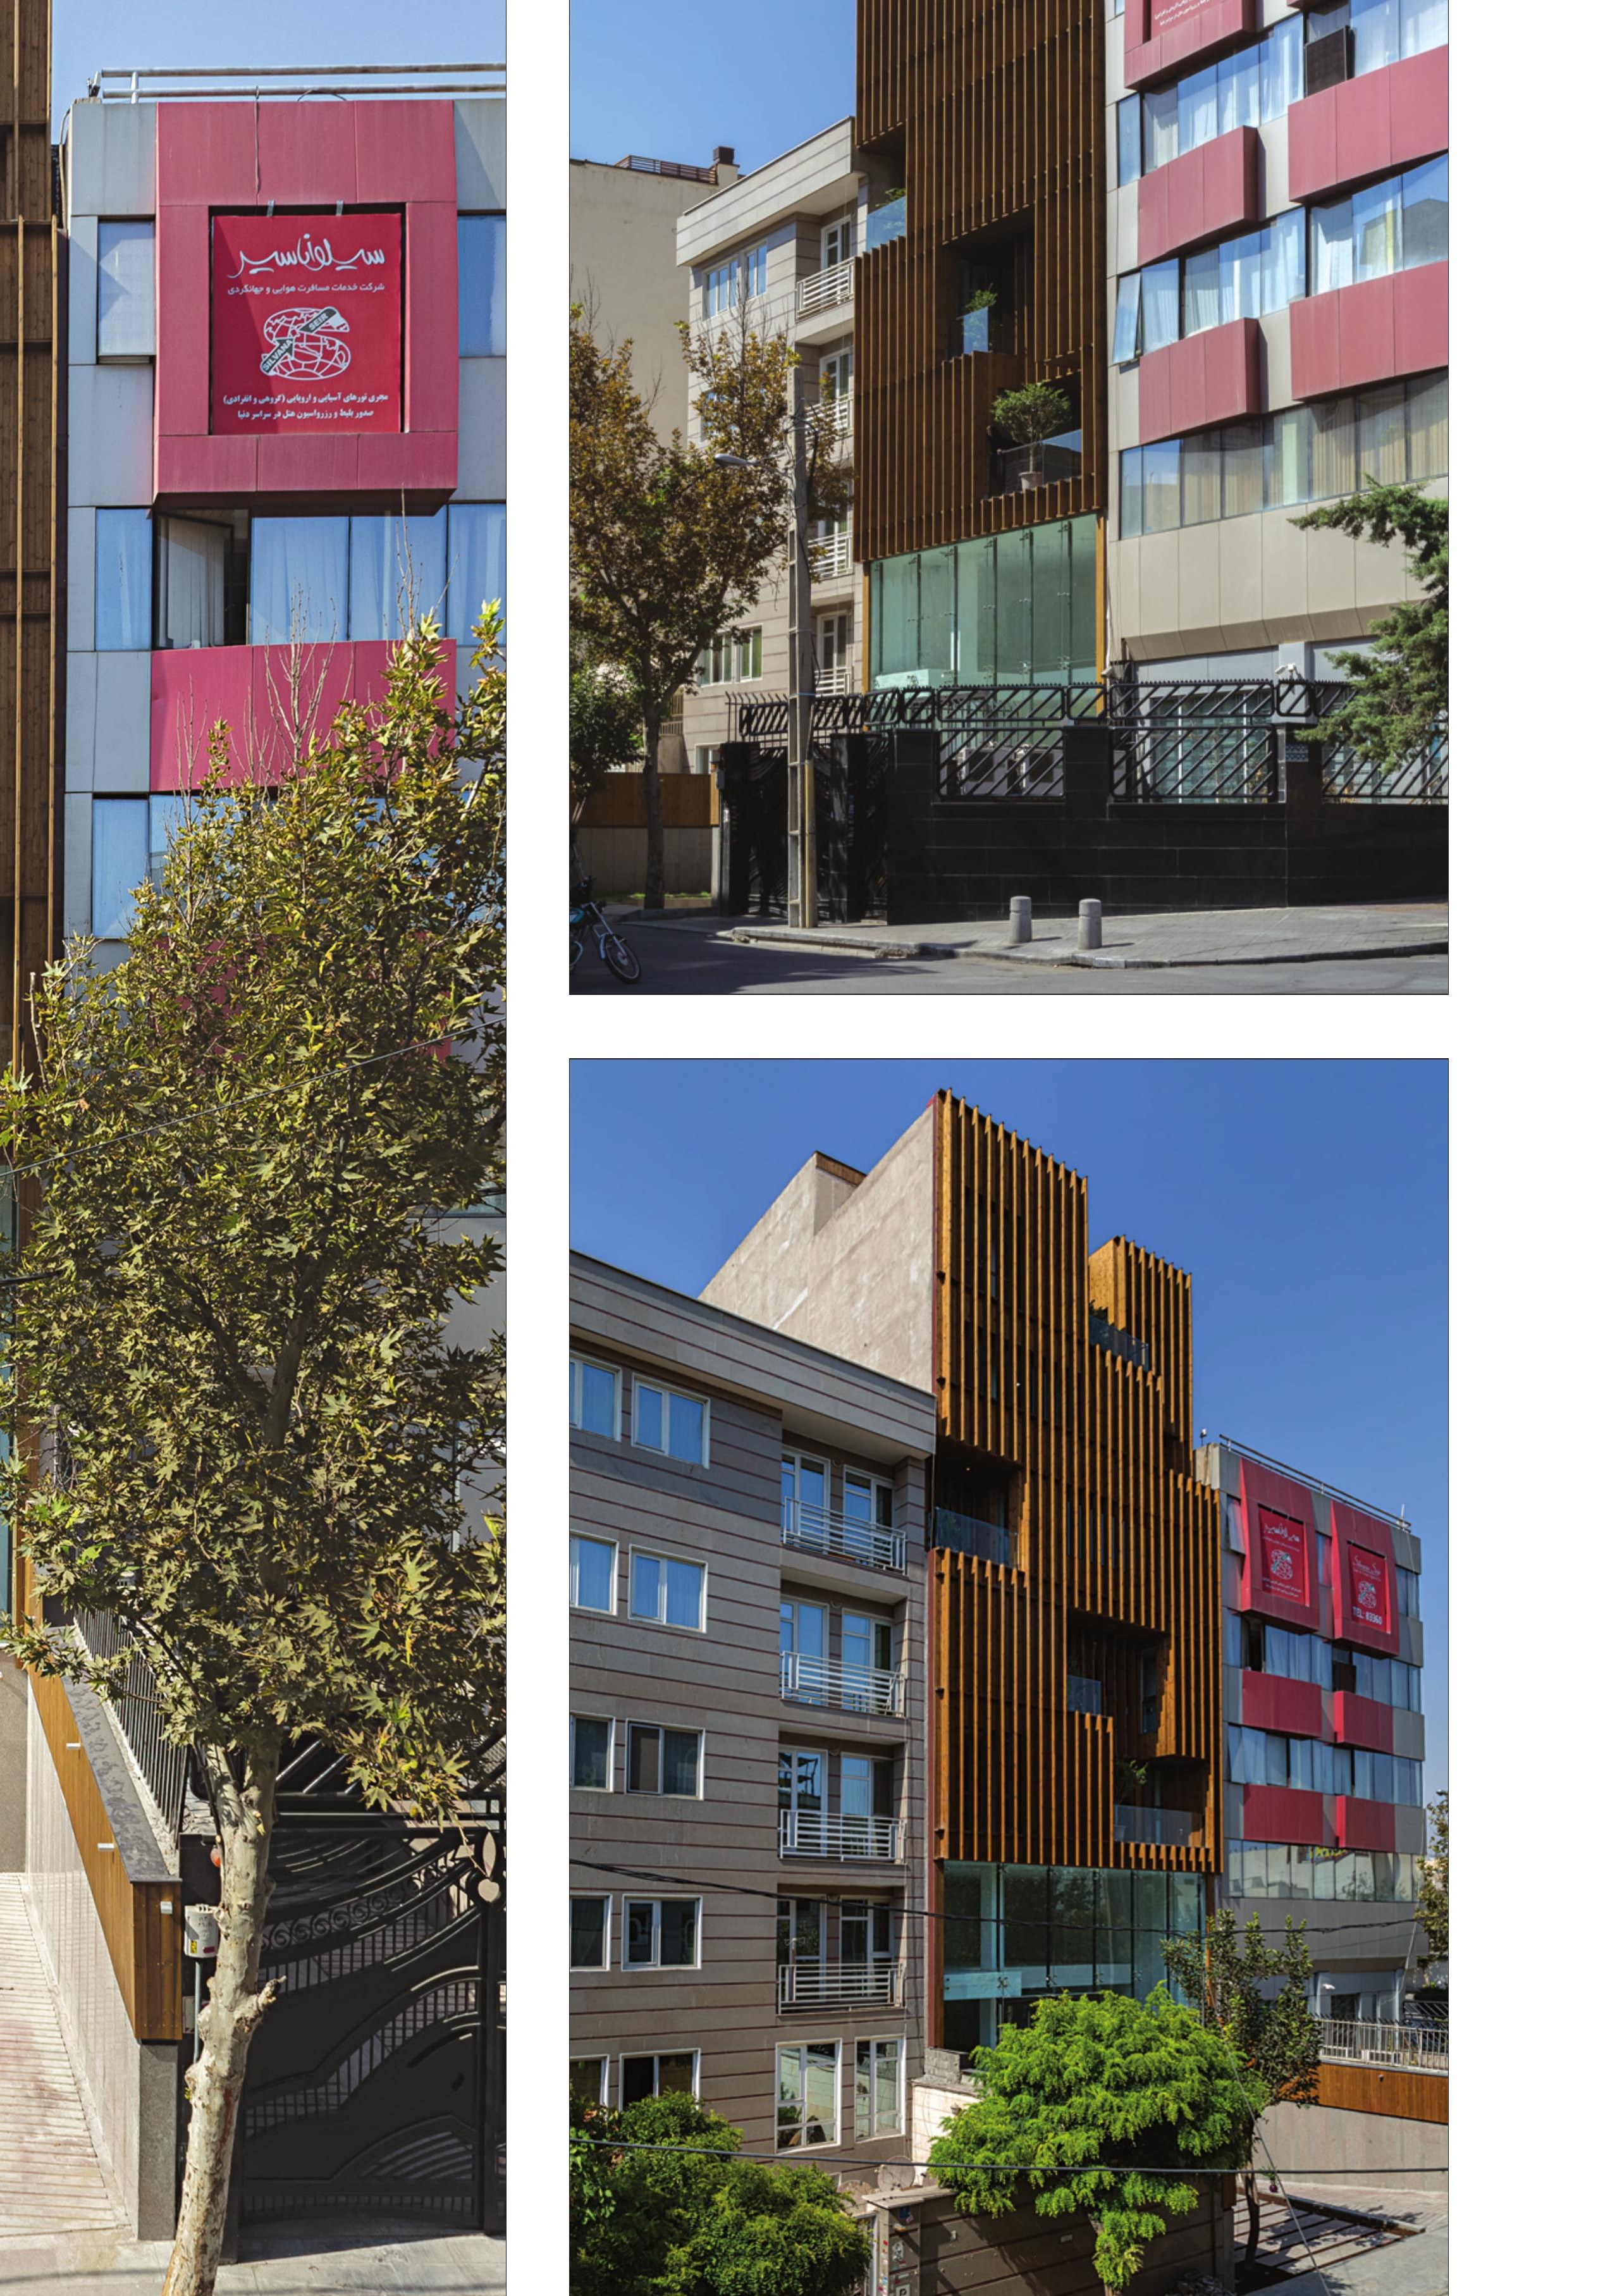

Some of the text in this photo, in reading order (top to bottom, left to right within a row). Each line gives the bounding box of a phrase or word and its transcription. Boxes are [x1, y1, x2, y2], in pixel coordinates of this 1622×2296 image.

[228, 282, 385, 295] شرکت خدمات مسافرت هوایی و جهانگردی
[308, 313, 329, 331] SEIR
[262, 339, 293, 371] SILVANA
[286, 393, 312, 404] اروپایی
[312, 395, 317, 404] و
[318, 392, 341, 403] آسیایی
[368, 395, 388, 403] مجری
[238, 410, 250, 419] دنیا
[251, 410, 271, 420] سراسر
[273, 411, 281, 419] در
[282, 409, 295, 419] هتل
[297, 409, 333, 419] رزرواسیون
[340, 408, 353, 418] بلیط
[355, 410, 374, 419] صدور
